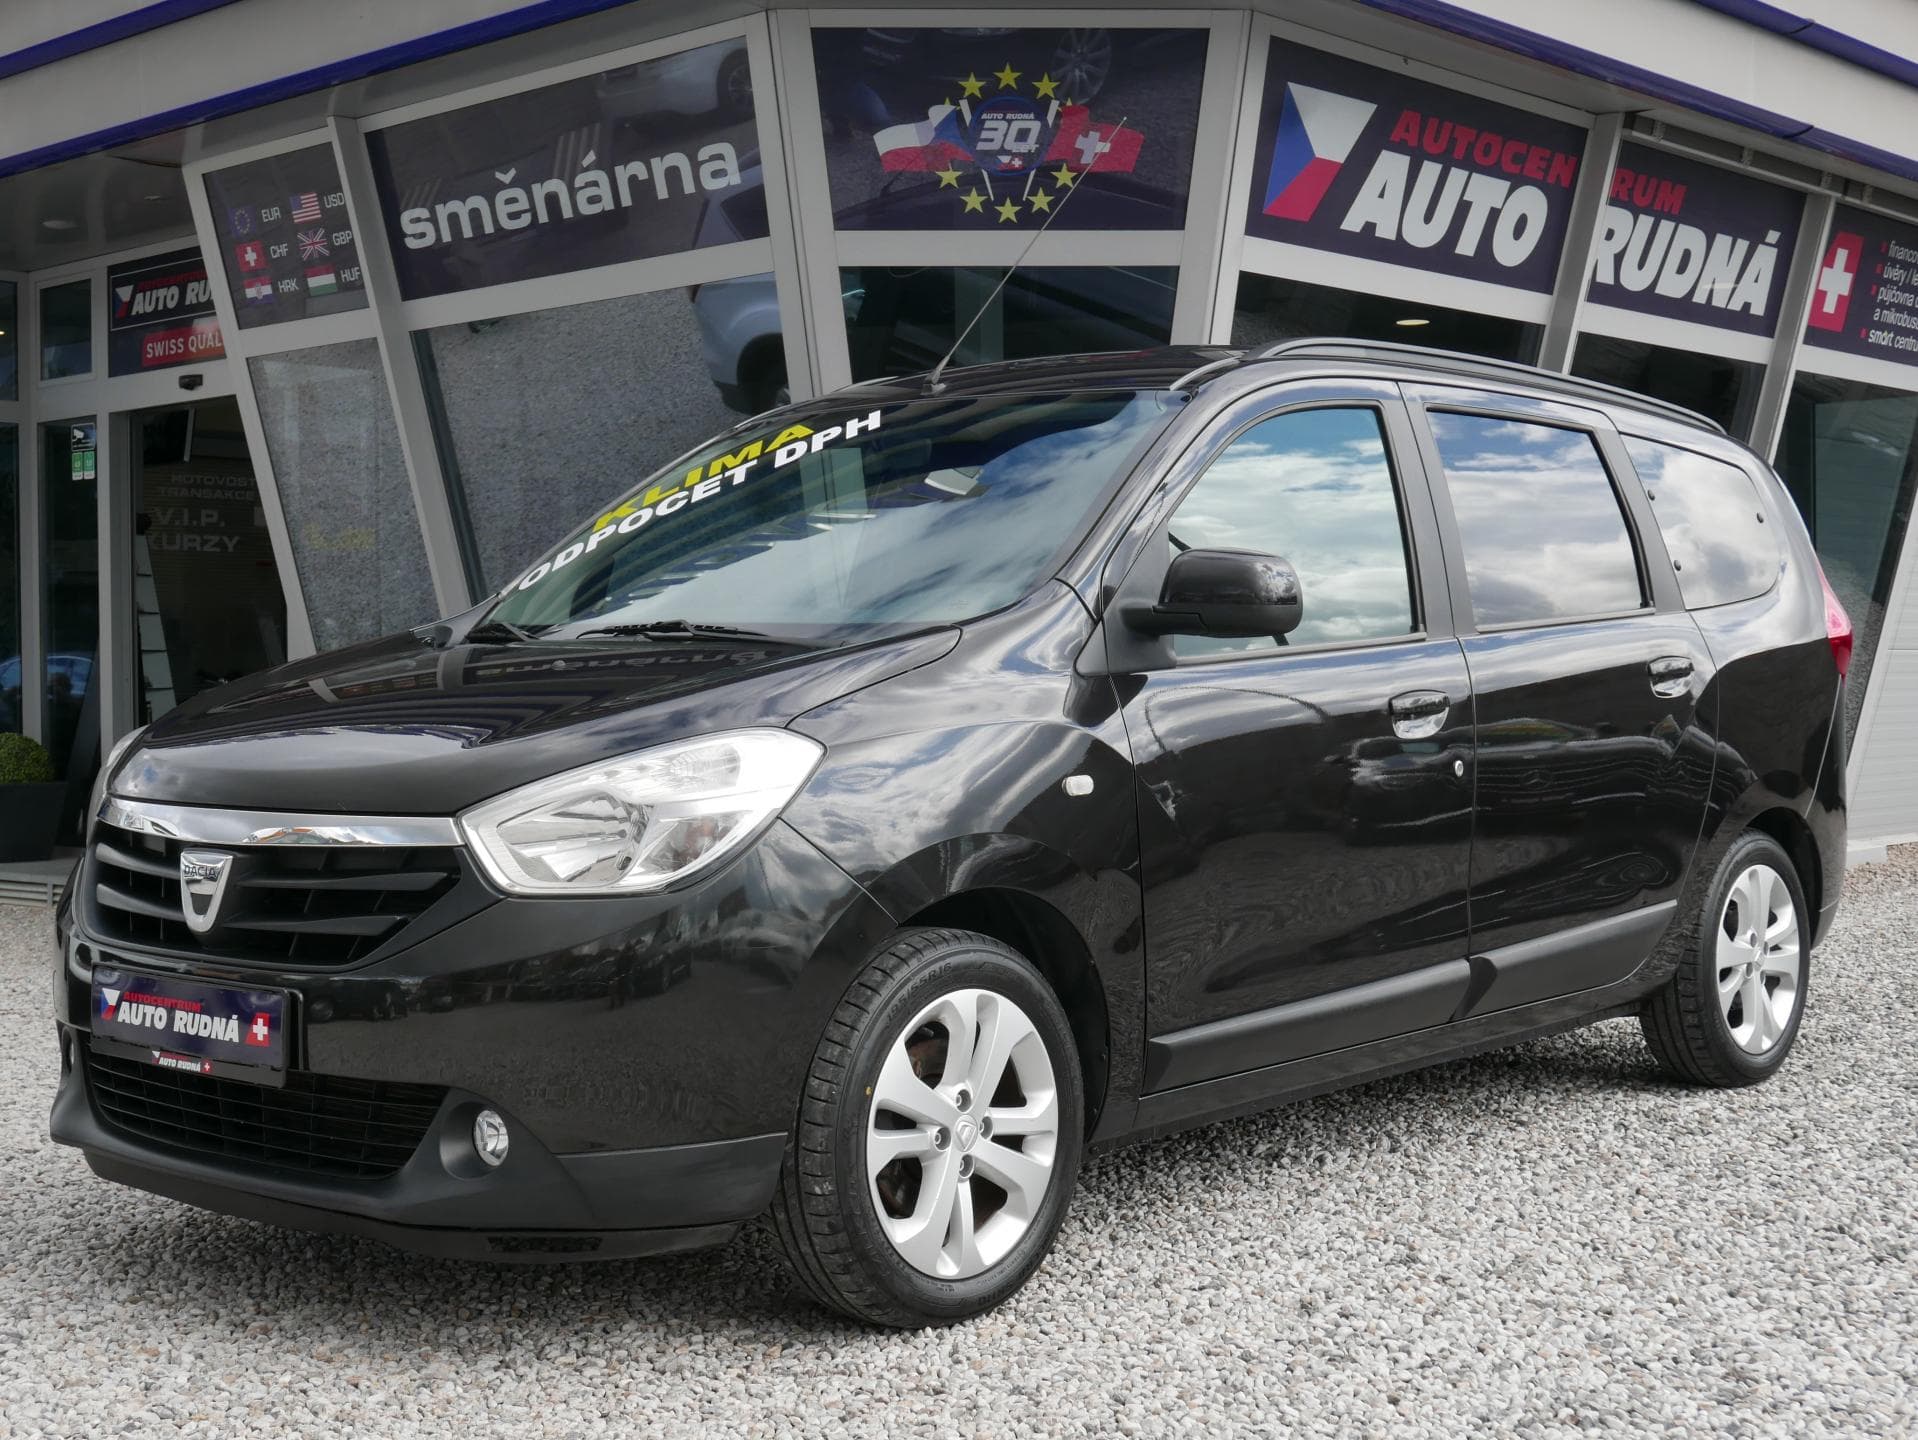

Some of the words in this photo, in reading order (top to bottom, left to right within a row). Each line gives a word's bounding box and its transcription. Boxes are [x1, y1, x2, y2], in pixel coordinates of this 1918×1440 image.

[975, 120, 1041, 151] 30
[261, 207, 281, 222] EUR
[323, 192, 345, 208] USD
[400, 141, 742, 250] směnárna
[269, 243, 289, 259] CHF
[332, 230, 353, 246] GBP
[1339, 149, 1549, 268] AUTO
[1596, 203, 1782, 317] RUDNÁ
[278, 278, 299, 293] HRK
[340, 266, 361, 282] HUF
[130, 285, 180, 316] AUTO
[185, 279, 214, 305] RU
[1873, 308, 1881, 321] a
[146, 338, 184, 358] SWISS
[592, 424, 815, 532] KLIMA
[518, 459, 760, 591] ODPOCET
[774, 409, 882, 468] DPH
[184, 864, 217, 879] DACIA
[117, 1001, 168, 1030] AUTO
[173, 1010, 240, 1042] RUDNÁ
[159, 1056, 177, 1067] AUTO
[176, 1059, 201, 1072] RUDNÁ
